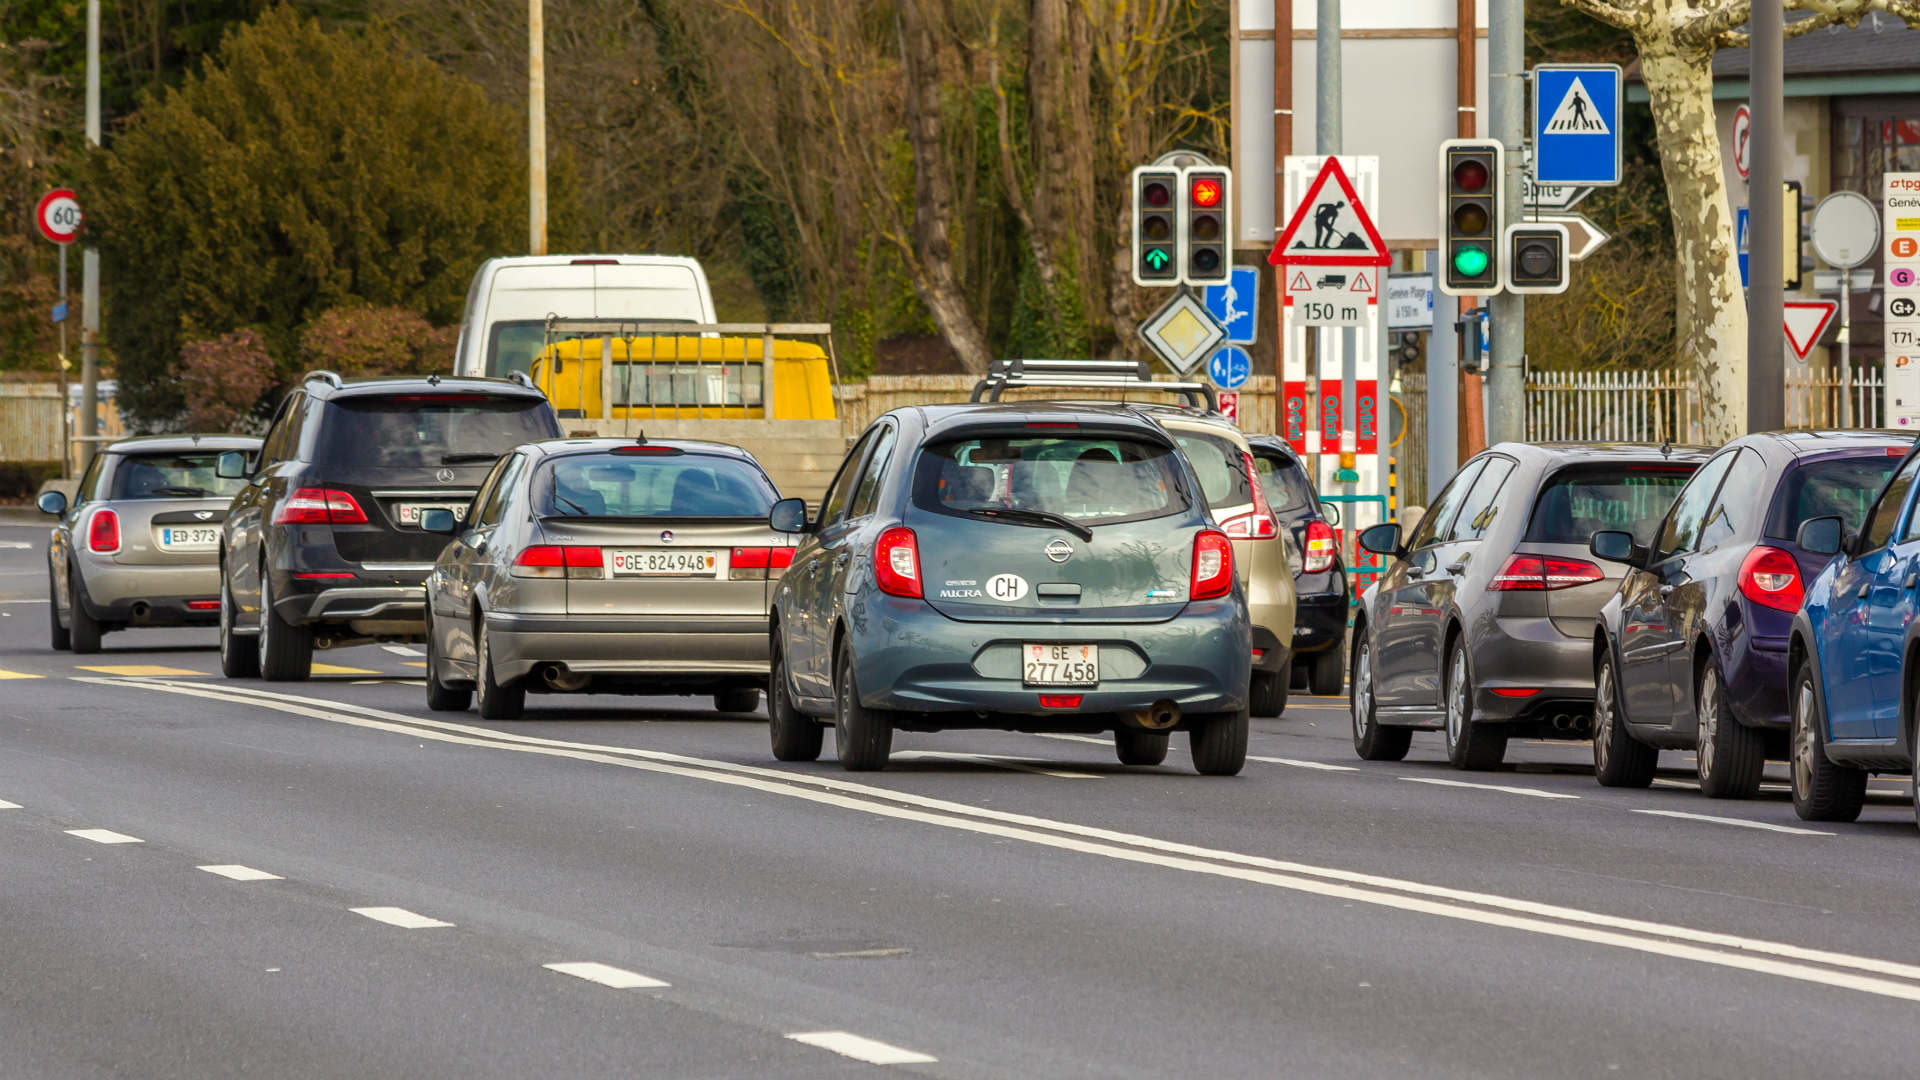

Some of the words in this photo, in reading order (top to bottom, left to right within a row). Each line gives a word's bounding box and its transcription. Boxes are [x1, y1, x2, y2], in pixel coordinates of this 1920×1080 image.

[1523, 182, 1561, 201] apite
[53, 206, 74, 225] 60
[1899, 241, 1910, 254] E
[1896, 271, 1908, 283] G
[1304, 303, 1334, 320] 150
[1342, 307, 1357, 320] m
[1892, 301, 1913, 314] G+
[1892, 332, 1912, 343] T71
[940, 589, 982, 598] MICRA
[995, 577, 1018, 597] CH
[1052, 646, 1069, 660] GE
